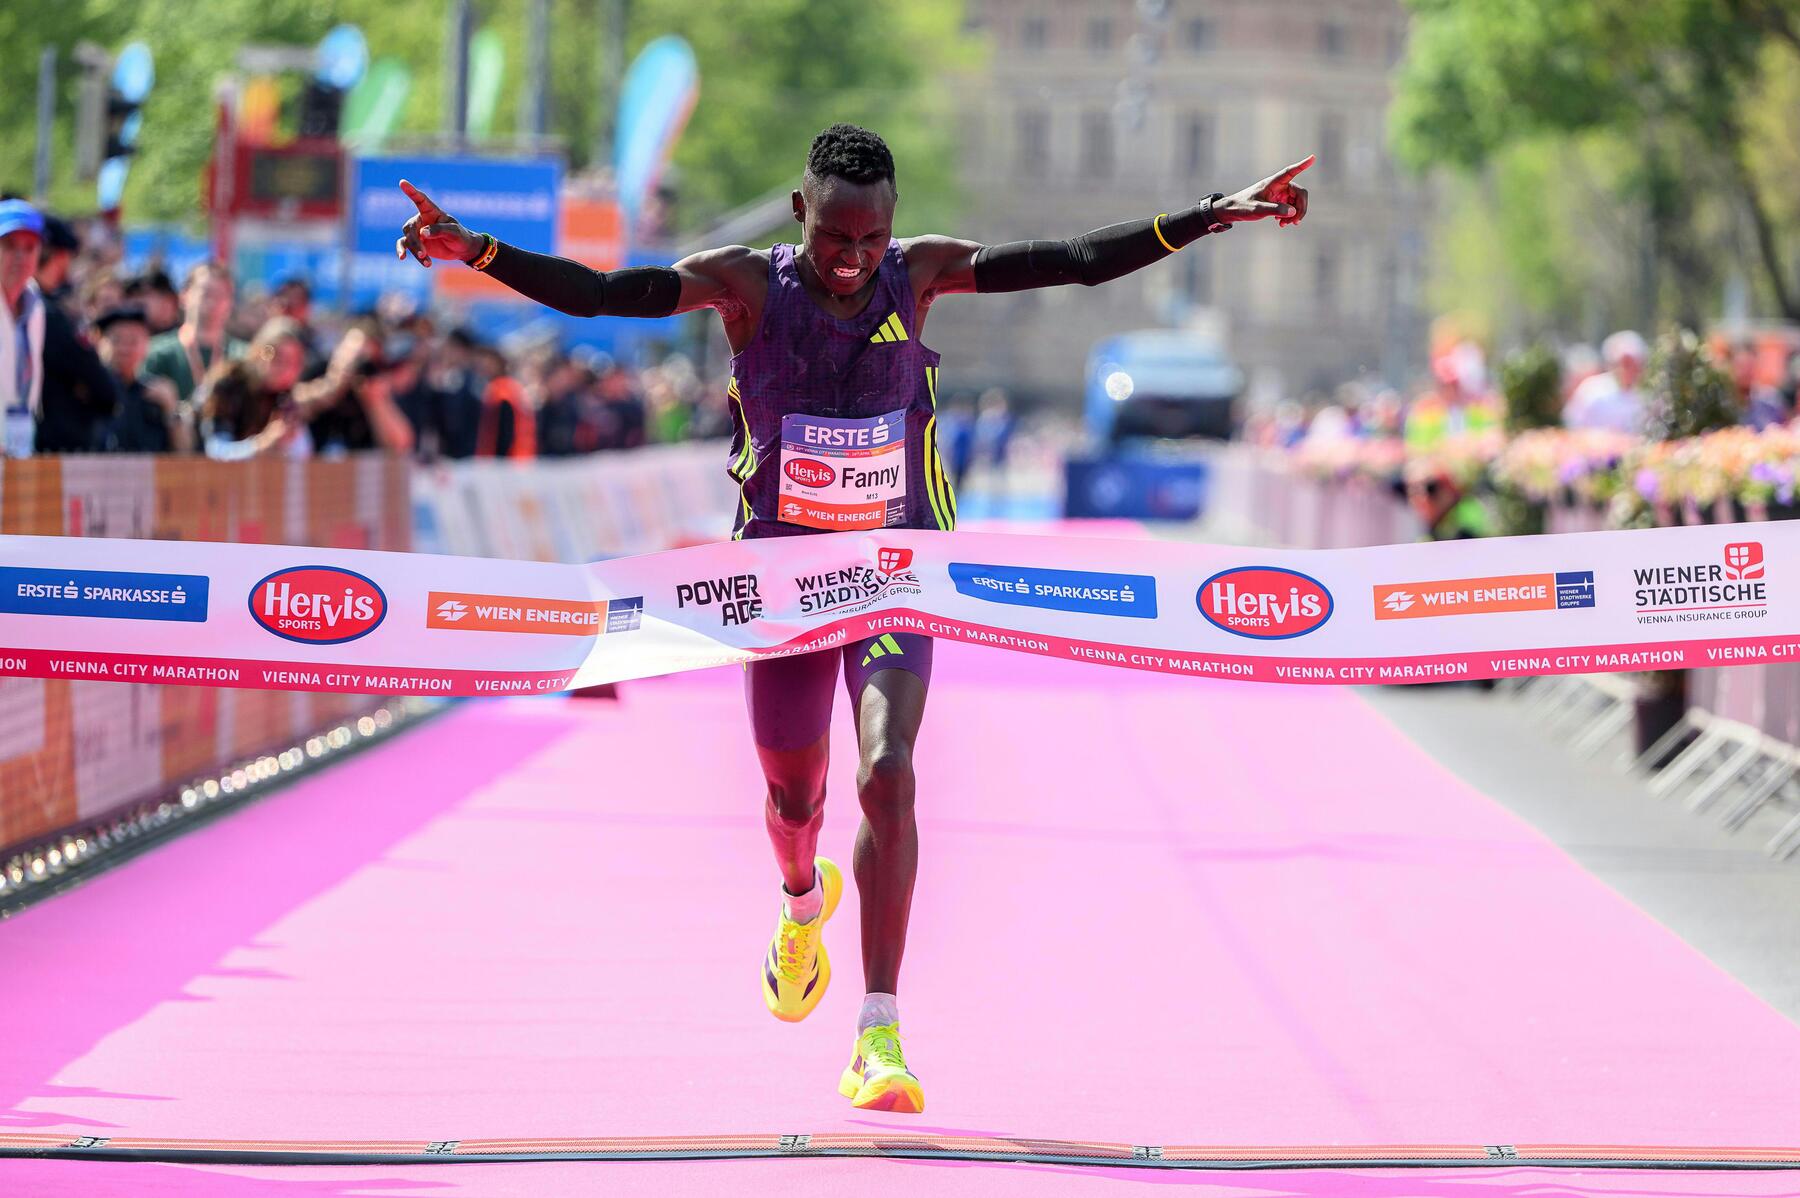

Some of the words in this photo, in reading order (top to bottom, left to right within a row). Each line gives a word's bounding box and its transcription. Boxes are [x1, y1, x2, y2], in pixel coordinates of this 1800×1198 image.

[803, 424, 870, 447] ERSTE
[789, 461, 831, 483] Hervis
[841, 465, 900, 489] Fanny
[866, 492, 879, 501] M13
[806, 508, 835, 522] WIEN
[837, 510, 882, 522] ENERGIE
[795, 566, 875, 593] WIENER
[1633, 564, 1722, 585] WIENER
[17, 583, 62, 600] ERSTE
[83, 586, 170, 604] SPARKASSE
[676, 574, 760, 608] POWER
[889, 585, 922, 598] GROUP
[971, 576, 1015, 594] ERSTE
[1034, 584, 1119, 602] SPARKASSE
[1421, 590, 1470, 607] WIEN
[1473, 585, 1547, 603] ENERGIE
[1635, 583, 1767, 606] STÄDTISCHE
[264, 582, 375, 627] Hervis
[475, 604, 522, 621] WIEN
[526, 608, 600, 625] ENERGIE
[721, 598, 763, 627] ADE
[1211, 582, 1321, 625] Hervis
[278, 618, 322, 631] SPORTS
[1227, 615, 1270, 628] SPORTS
[1636, 615, 1674, 625] VIENNA
[1675, 611, 1731, 623] INSURANCE
[1733, 609, 1768, 619] GROUP
[769, 628, 846, 656] MARATHON
[866, 616, 926, 631] VIENNA
[929, 621, 962, 635] CITY
[966, 629, 1050, 652] MARATHON
[1070, 645, 1127, 663] VIENNA
[1131, 654, 1165, 668] CITY
[1168, 658, 1254, 676] MARATHON
[1490, 656, 1552, 672] VIENNA
[1555, 654, 1591, 668] CITY
[1595, 649, 1684, 666] MARATHON
[1707, 644, 1768, 660] VIENNA
[49, 660, 109, 675] VIENNA
[113, 663, 148, 677] CITY
[152, 664, 240, 681] MARATHON
[262, 670, 322, 685] VIENNA
[326, 673, 361, 687] CITY
[365, 674, 452, 690] MARATHON
[1276, 665, 1335, 679] VIENNA
[1339, 664, 1374, 678] CITY
[1379, 661, 1468, 678] MARATHON
[474, 677, 532, 691] VIENNA
[536, 676, 570, 690] CITY
